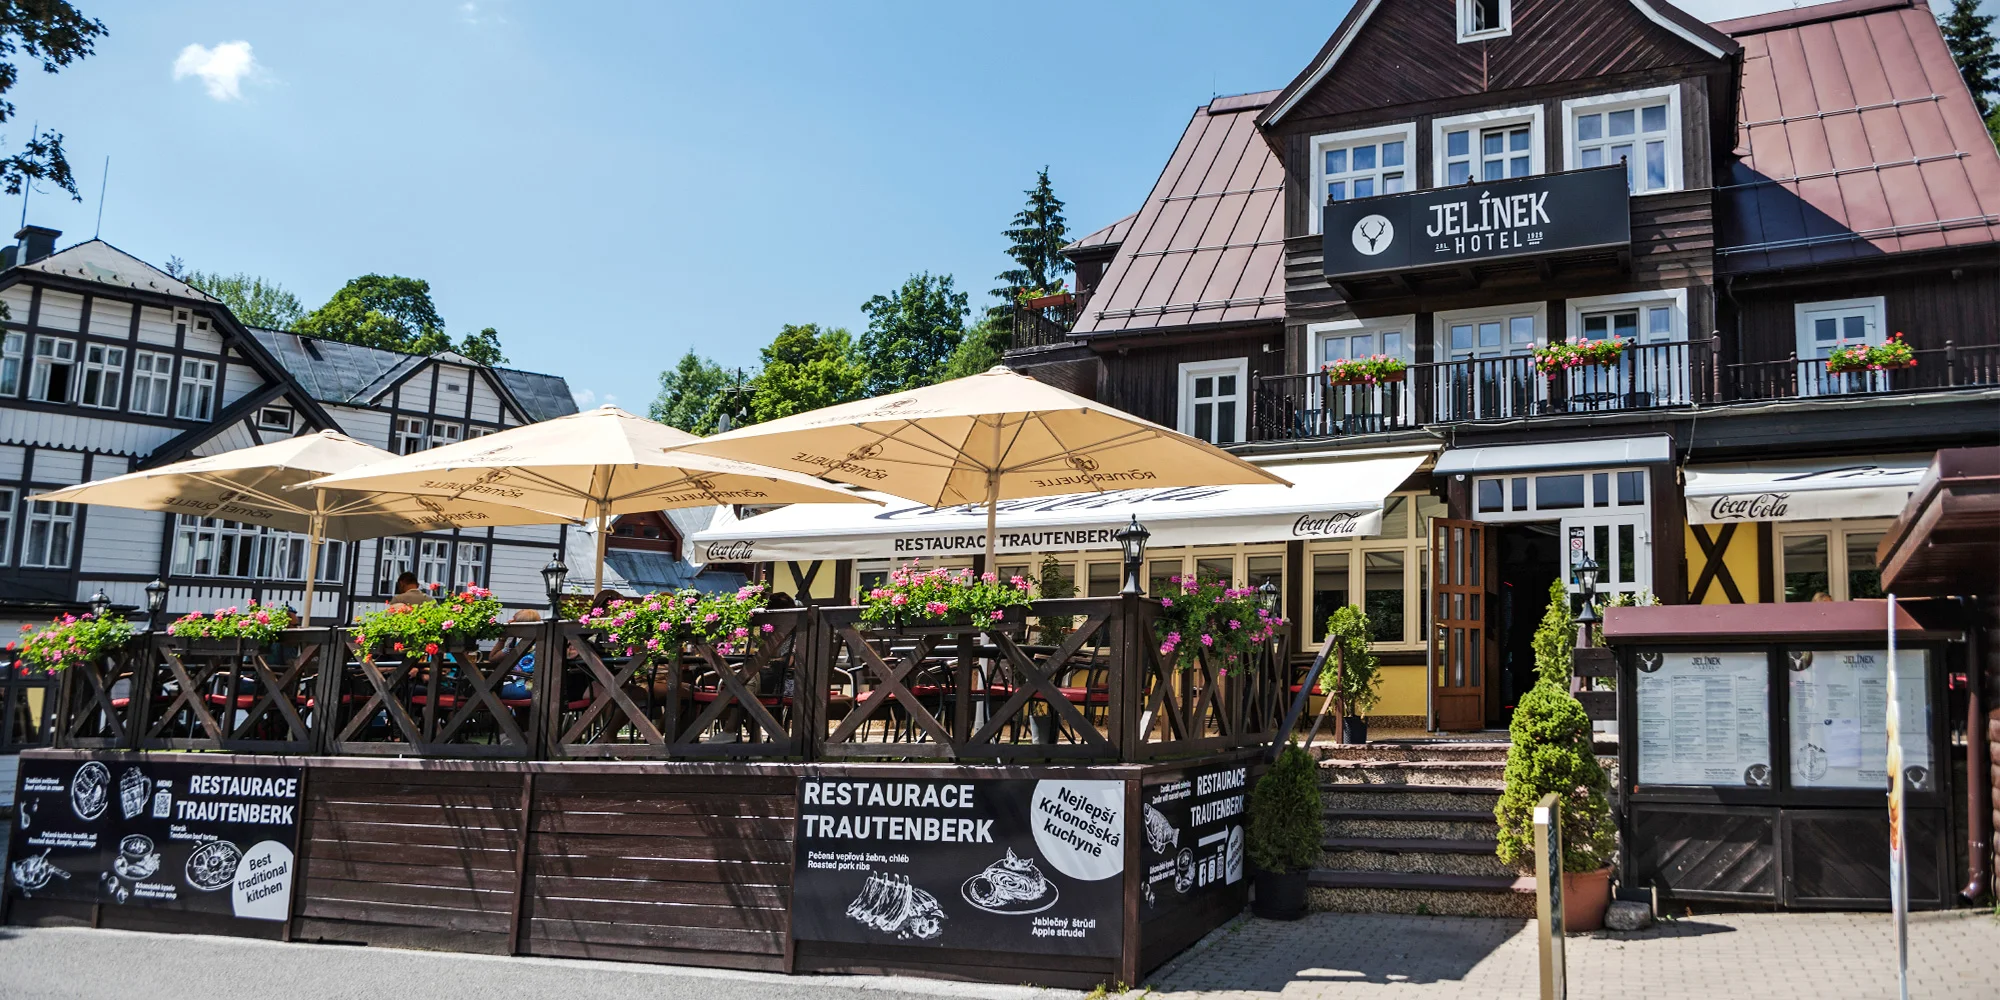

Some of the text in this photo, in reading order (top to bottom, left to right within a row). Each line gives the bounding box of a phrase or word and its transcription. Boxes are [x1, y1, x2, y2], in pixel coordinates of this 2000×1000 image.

[1426, 190, 1551, 237] JELÍNEK
[1455, 230, 1523, 254] HOTEL
[895, 529, 1120, 551] RESTAURAC TRAUTENBERK
[157, 780, 173, 788] MENU
[190, 775, 298, 797] RESTAURACE
[1197, 768, 1246, 796] RESTAURACE
[804, 782, 975, 808] RESTAURACE
[1058, 787, 1117, 825] Nejlepší
[176, 801, 295, 824] TRAUTENBERK
[1039, 797, 1121, 847] Krkonošská
[1190, 794, 1245, 827] TRAUTENBERK
[802, 815, 994, 844] TRAUTENBERK
[1044, 818, 1102, 857] kuchyně
[249, 853, 272, 871] Best
[808, 851, 910, 864] Pečená vepřová žebra, chléb
[808, 861, 870, 871] Roasted pork ribs
[238, 861, 288, 891] traditional
[246, 881, 284, 903] kitchen
[1032, 917, 1068, 928] Jablečný
[1032, 927, 1085, 938] Apple strudel
